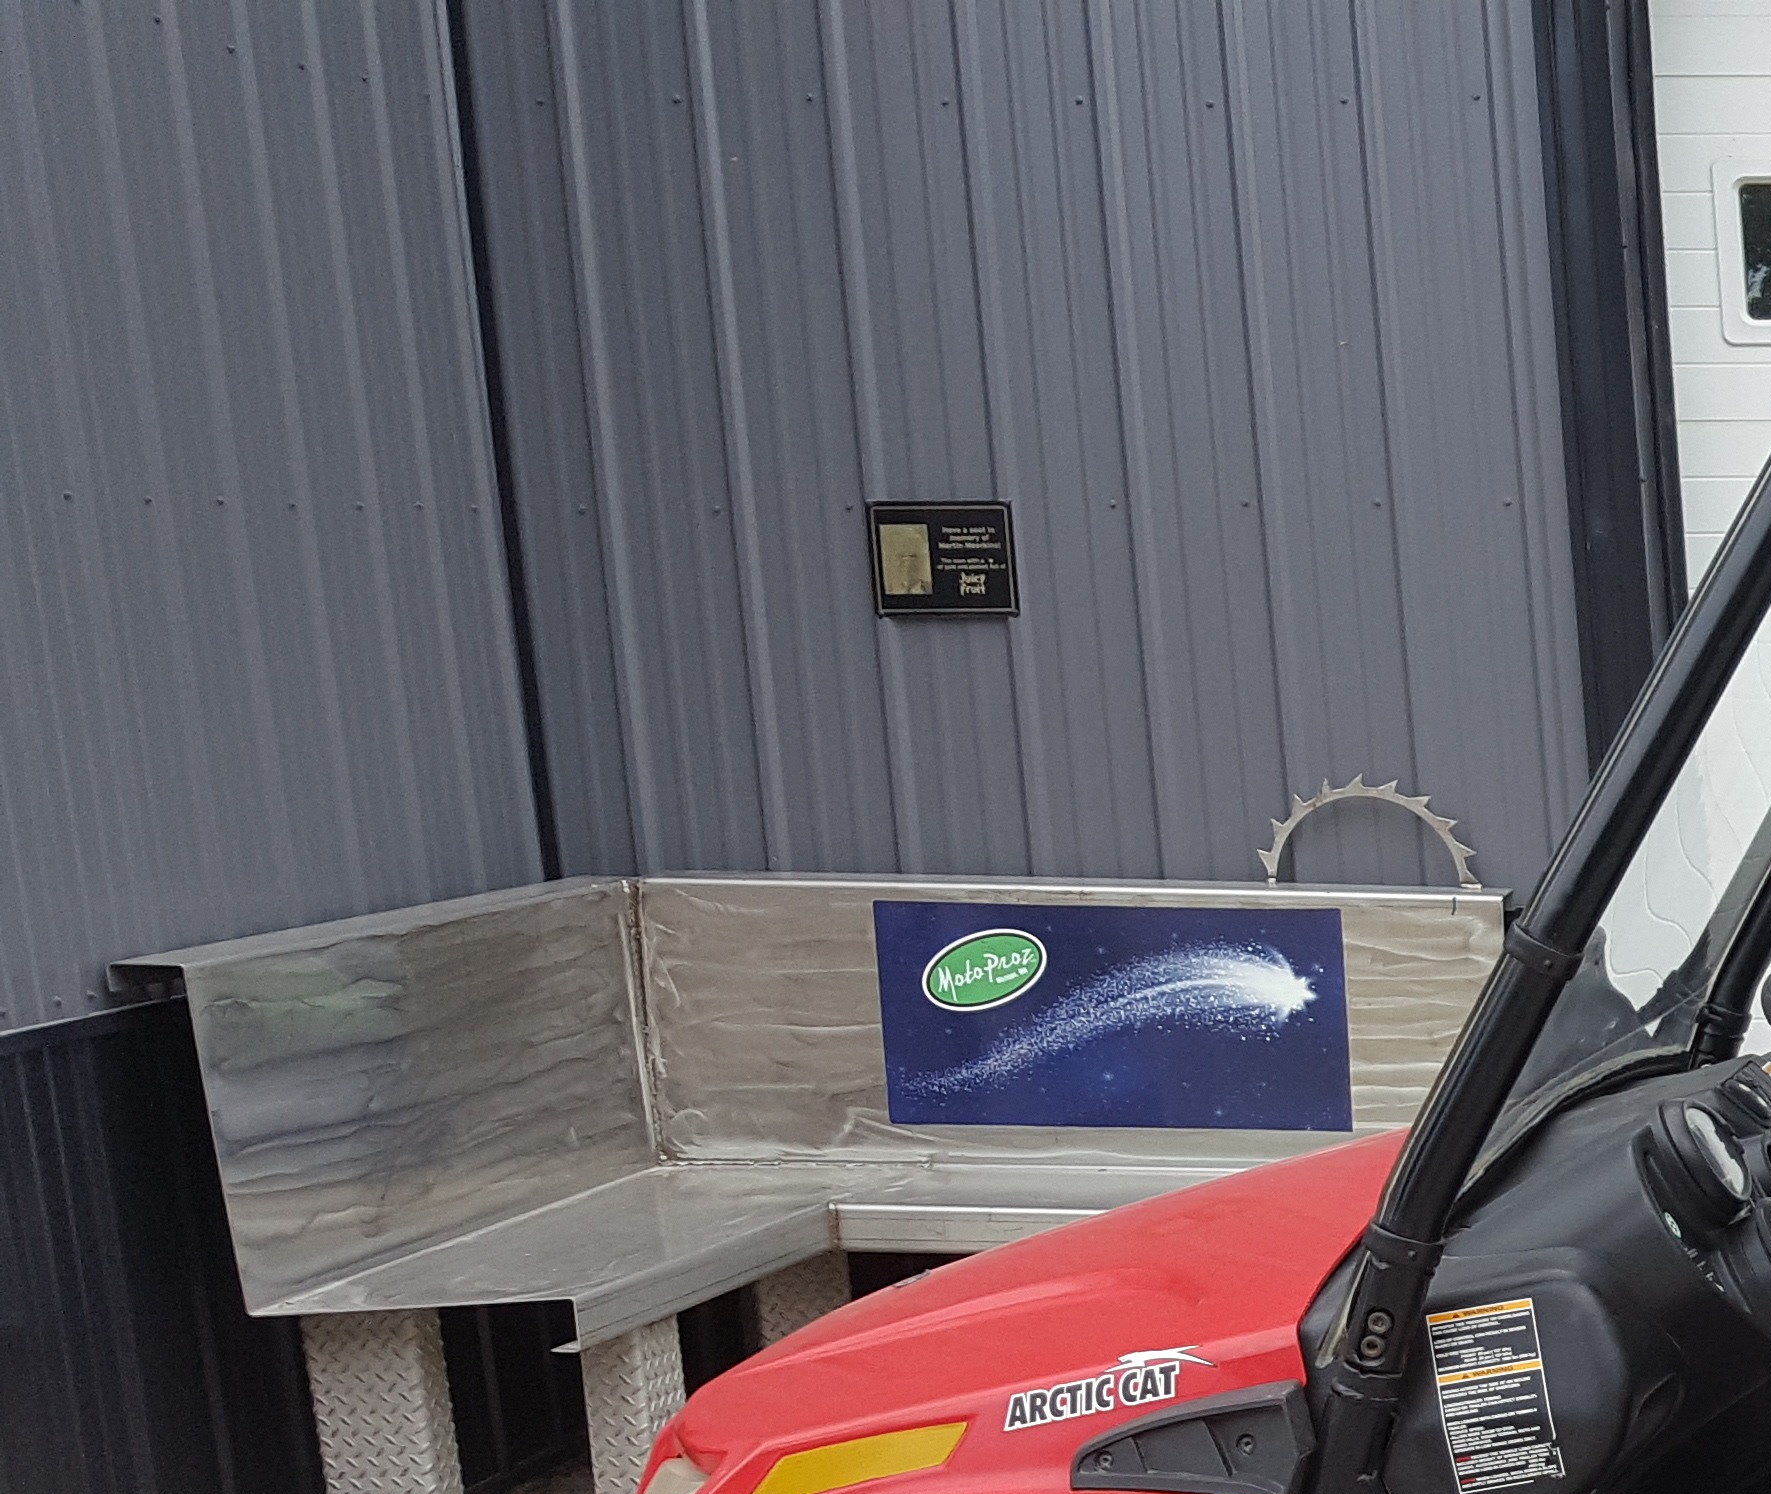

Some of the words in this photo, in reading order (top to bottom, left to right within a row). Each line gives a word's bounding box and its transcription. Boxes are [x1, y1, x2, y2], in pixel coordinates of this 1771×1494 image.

[958, 571, 986, 584] Juicy
[1473, 1365, 1514, 1377] WARNING
[1005, 1375, 1114, 1430] ARCTIC
[1119, 1362, 1179, 1406] CAT
